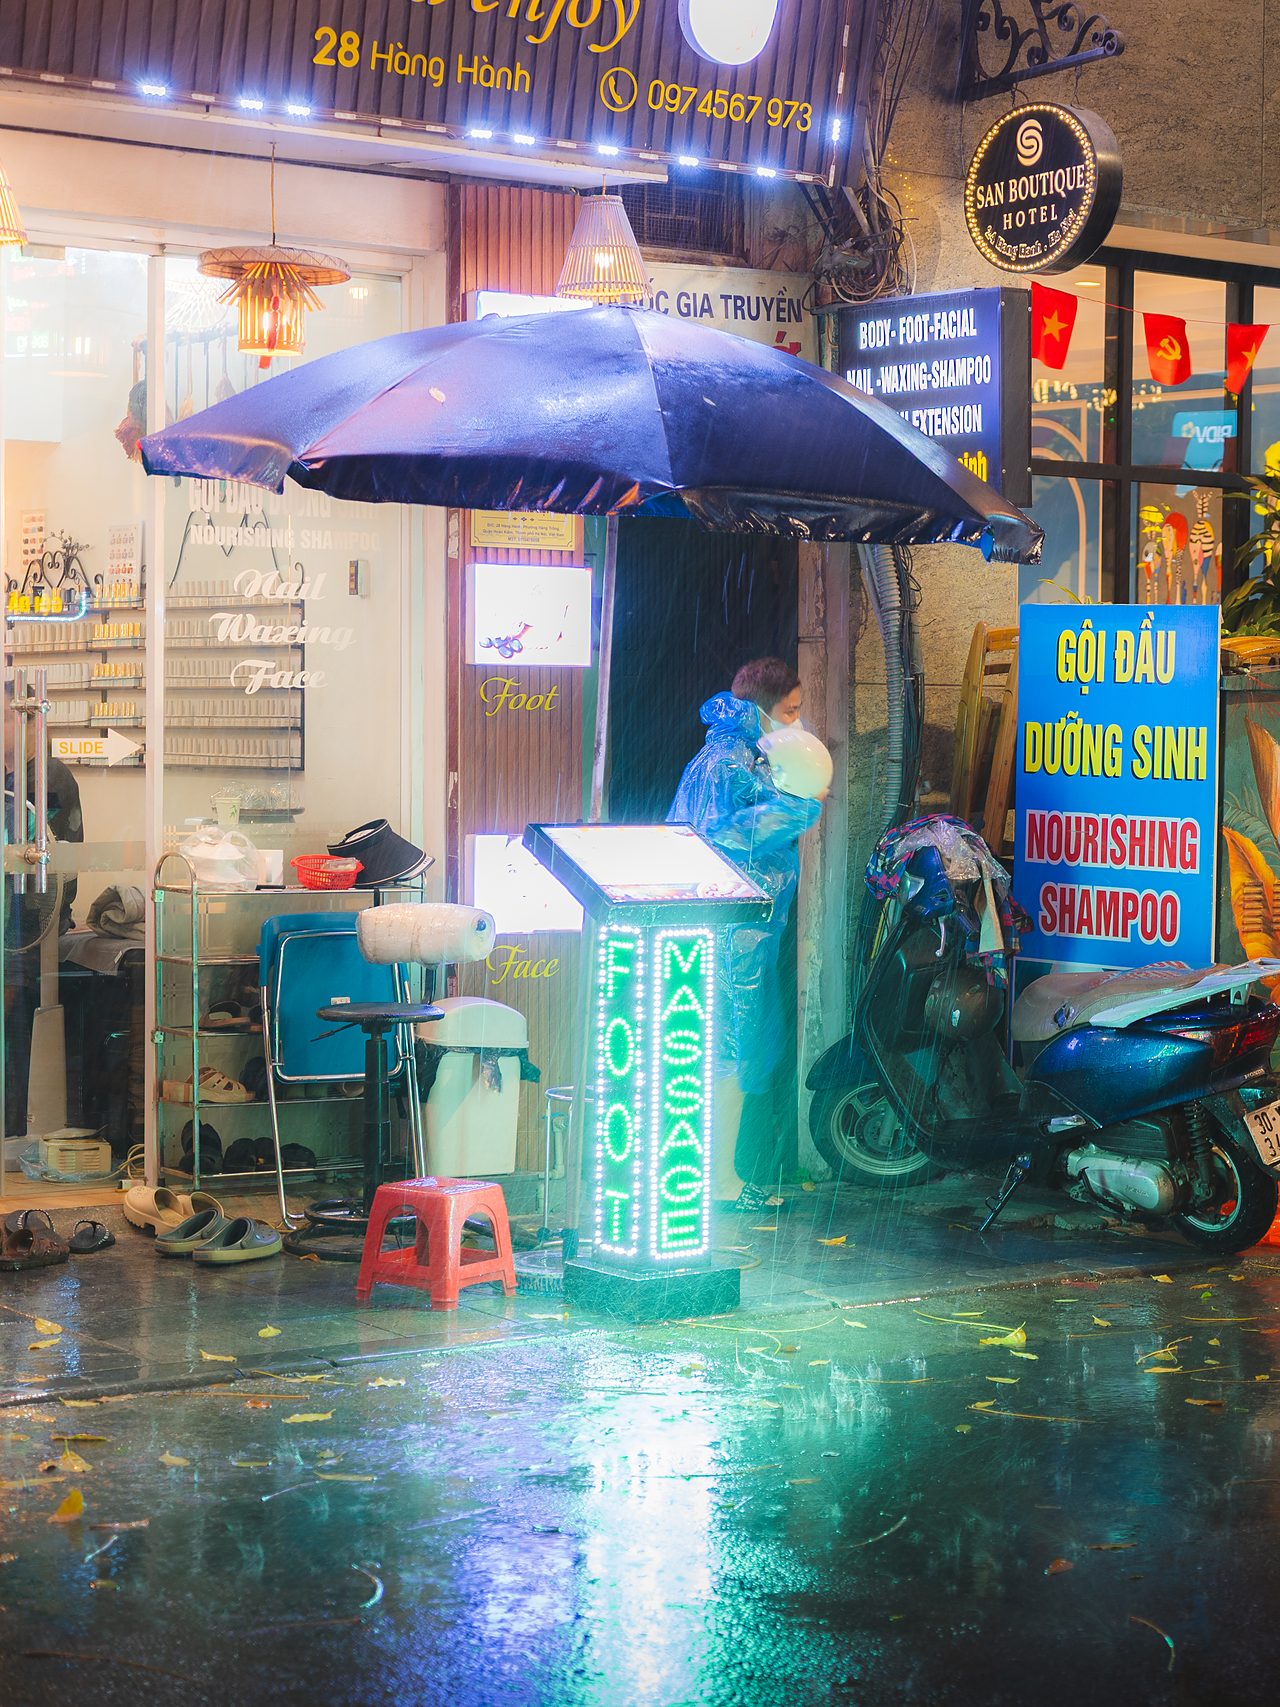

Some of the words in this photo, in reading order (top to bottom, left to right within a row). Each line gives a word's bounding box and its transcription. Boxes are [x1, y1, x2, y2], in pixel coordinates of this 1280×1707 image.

[313, 26, 360, 68] 28
[370, 41, 445, 88] Hàng
[456, 54, 530, 94] Hành
[976, 181, 1005, 210] SAN
[1008, 164, 1086, 204] BOUTIQUE
[1003, 204, 1058, 231] HOTEL
[676, 291, 715, 319] GIA
[719, 286, 803, 323] TRUYỀN
[912, 403, 983, 437] EXTENSION
[190, 524, 295, 549] NOURISHING
[301, 529, 382, 552] SHAMPOO
[233, 569, 328, 600] Nail
[208, 612, 357, 651] Waxing
[1057, 619, 1106, 695] GỘI
[1114, 612, 1177, 684] ĐẦU
[230, 659, 329, 695] Face
[479, 675, 560, 717] Foot
[58, 741, 105, 755] SLIDE
[1024, 710, 1124, 778] DƯỠNG
[1131, 724, 1208, 780] SINH
[1025, 809, 1201, 875] NOURISHING
[1039, 881, 1181, 947] SHAMPOO
[486, 943, 560, 985] Face
[603, 939, 636, 1243] FOOT
[659, 937, 709, 1250] MASSAGE
